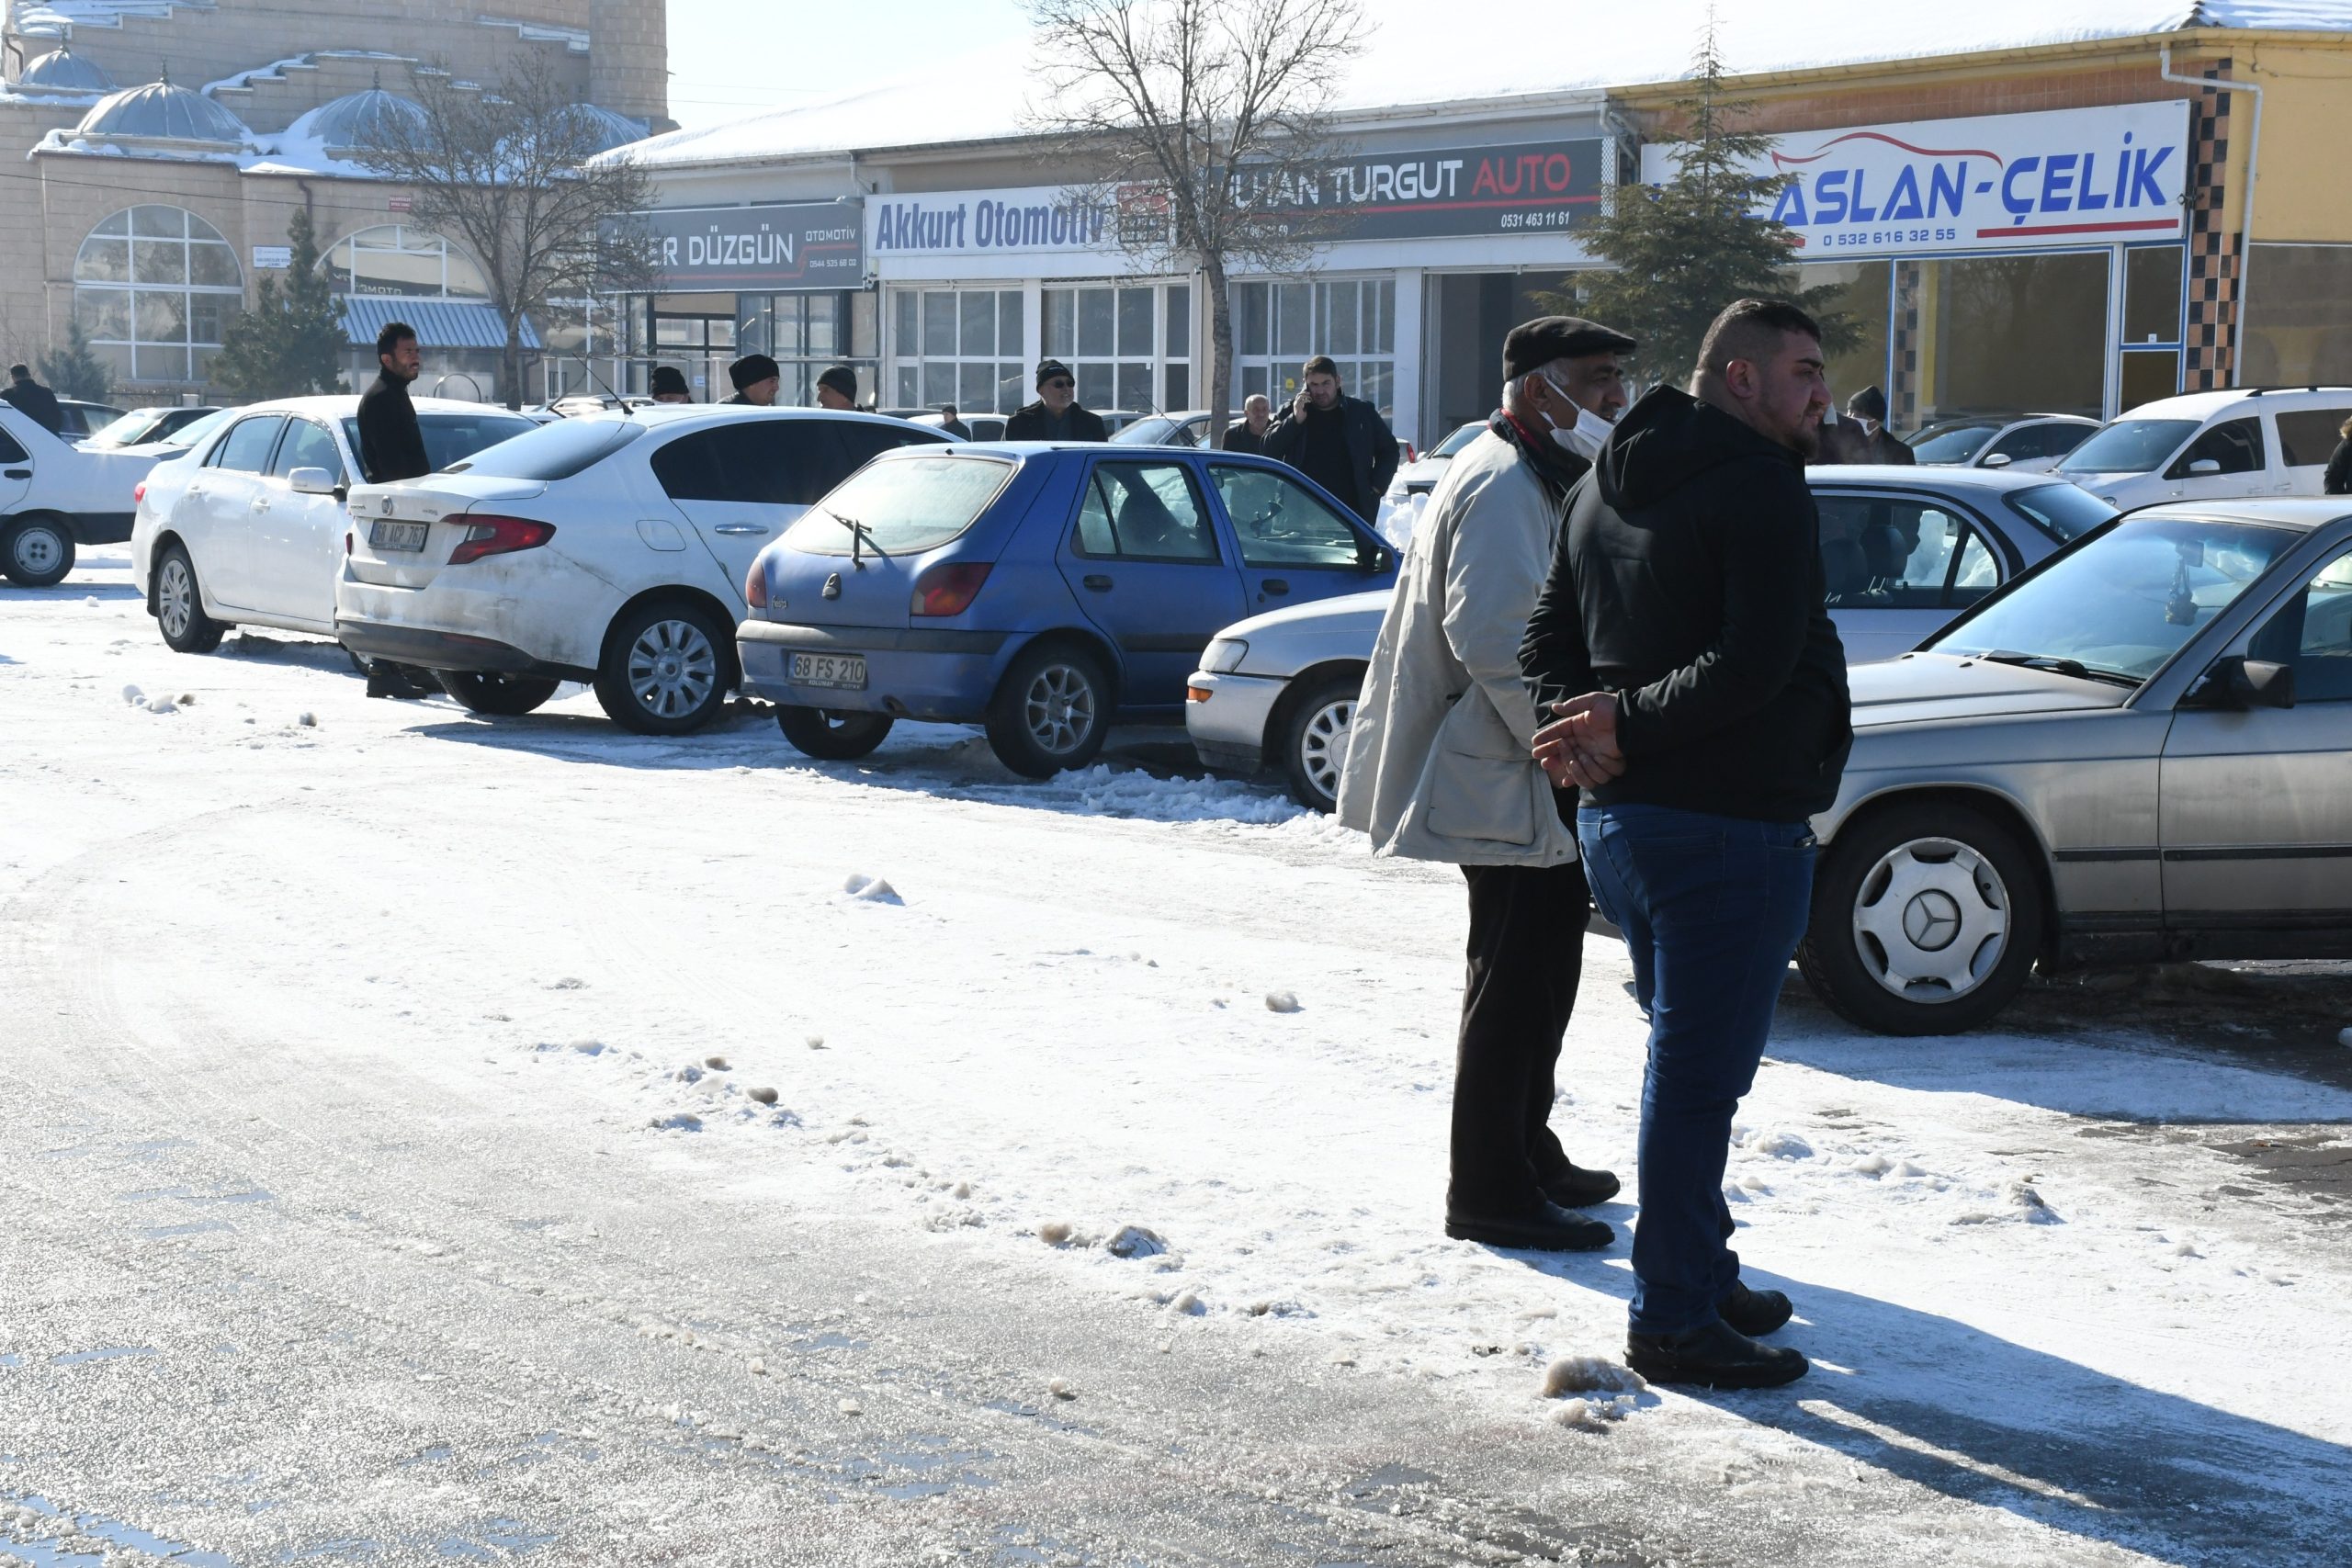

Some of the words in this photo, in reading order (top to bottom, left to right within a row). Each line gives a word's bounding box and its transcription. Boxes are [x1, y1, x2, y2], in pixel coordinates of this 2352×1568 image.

[1330, 159, 1464, 204] TURGUT
[1472, 153, 1572, 196] AUTO
[876, 203, 966, 251] Akkurt
[975, 195, 1106, 248] Otomotiv
[1501, 213, 1523, 228] 0531
[1525, 212, 1544, 227] 463
[1545, 211, 1556, 226] 11
[1558, 210, 1569, 225] 61
[689, 223, 793, 265] DÜZGÜN
[805, 224, 856, 242] OTOMOTİV
[1823, 234, 1832, 246] 0
[1838, 232, 1868, 245] 532
[1873, 231, 1904, 243] 616
[1909, 229, 1930, 243] 32
[1935, 228, 1956, 241] 55
[794, 656, 811, 677] 68
[815, 657, 834, 679] FS
[839, 660, 865, 682] 210
